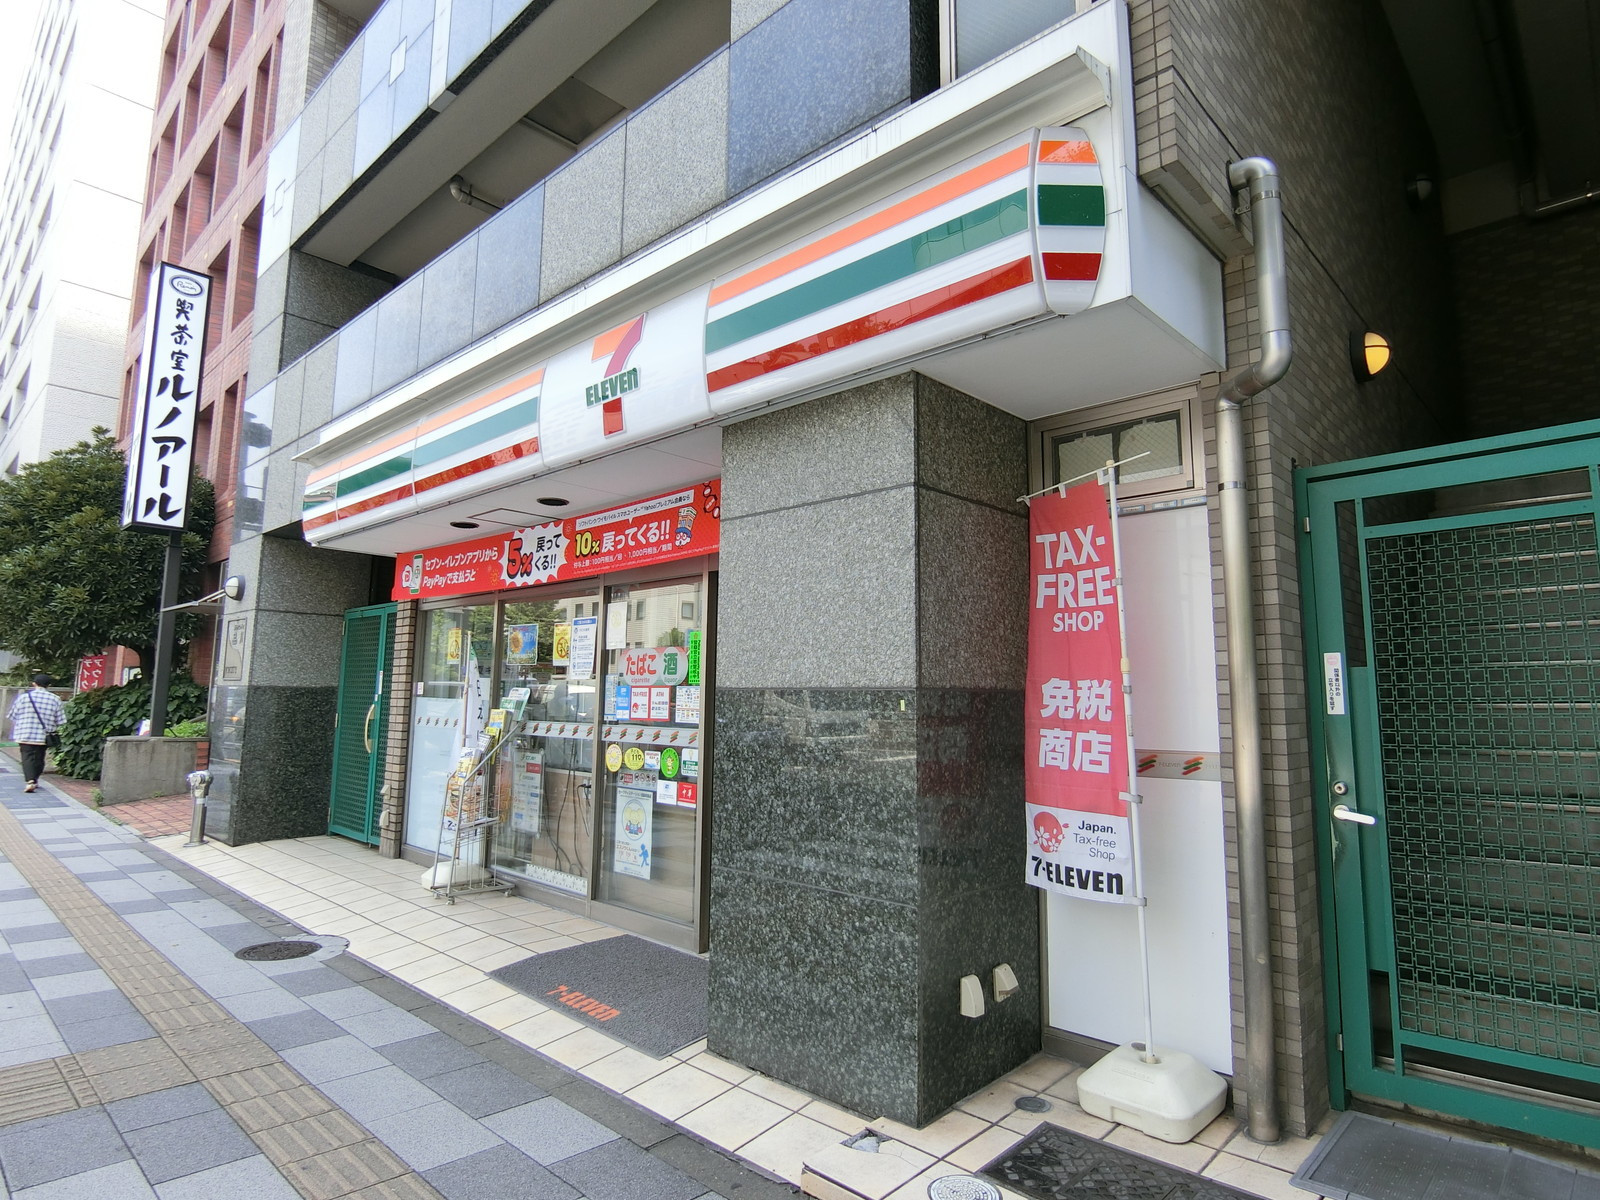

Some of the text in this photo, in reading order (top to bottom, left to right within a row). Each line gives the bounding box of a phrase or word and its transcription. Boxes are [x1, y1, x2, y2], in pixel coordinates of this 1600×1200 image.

[536, 533, 562, 553] 戻って
[574, 531, 600, 558] 10%
[1035, 524, 1106, 569] TAX-
[507, 537, 534, 580] 5%
[535, 553, 557, 571] くる!!
[423, 568, 477, 589] PayPayで支払うと
[1035, 565, 1114, 609] FREE
[1052, 610, 1105, 634] SHOP
[626, 653, 657, 676] たばこ
[663, 652, 678, 675] 酒
[1039, 677, 1113, 722] 免税
[1038, 727, 1113, 775] 商店
[1077, 820, 1117, 836] Japan.
[1073, 832, 1117, 850] Tax-free
[1089, 846, 1116, 862] Shop
